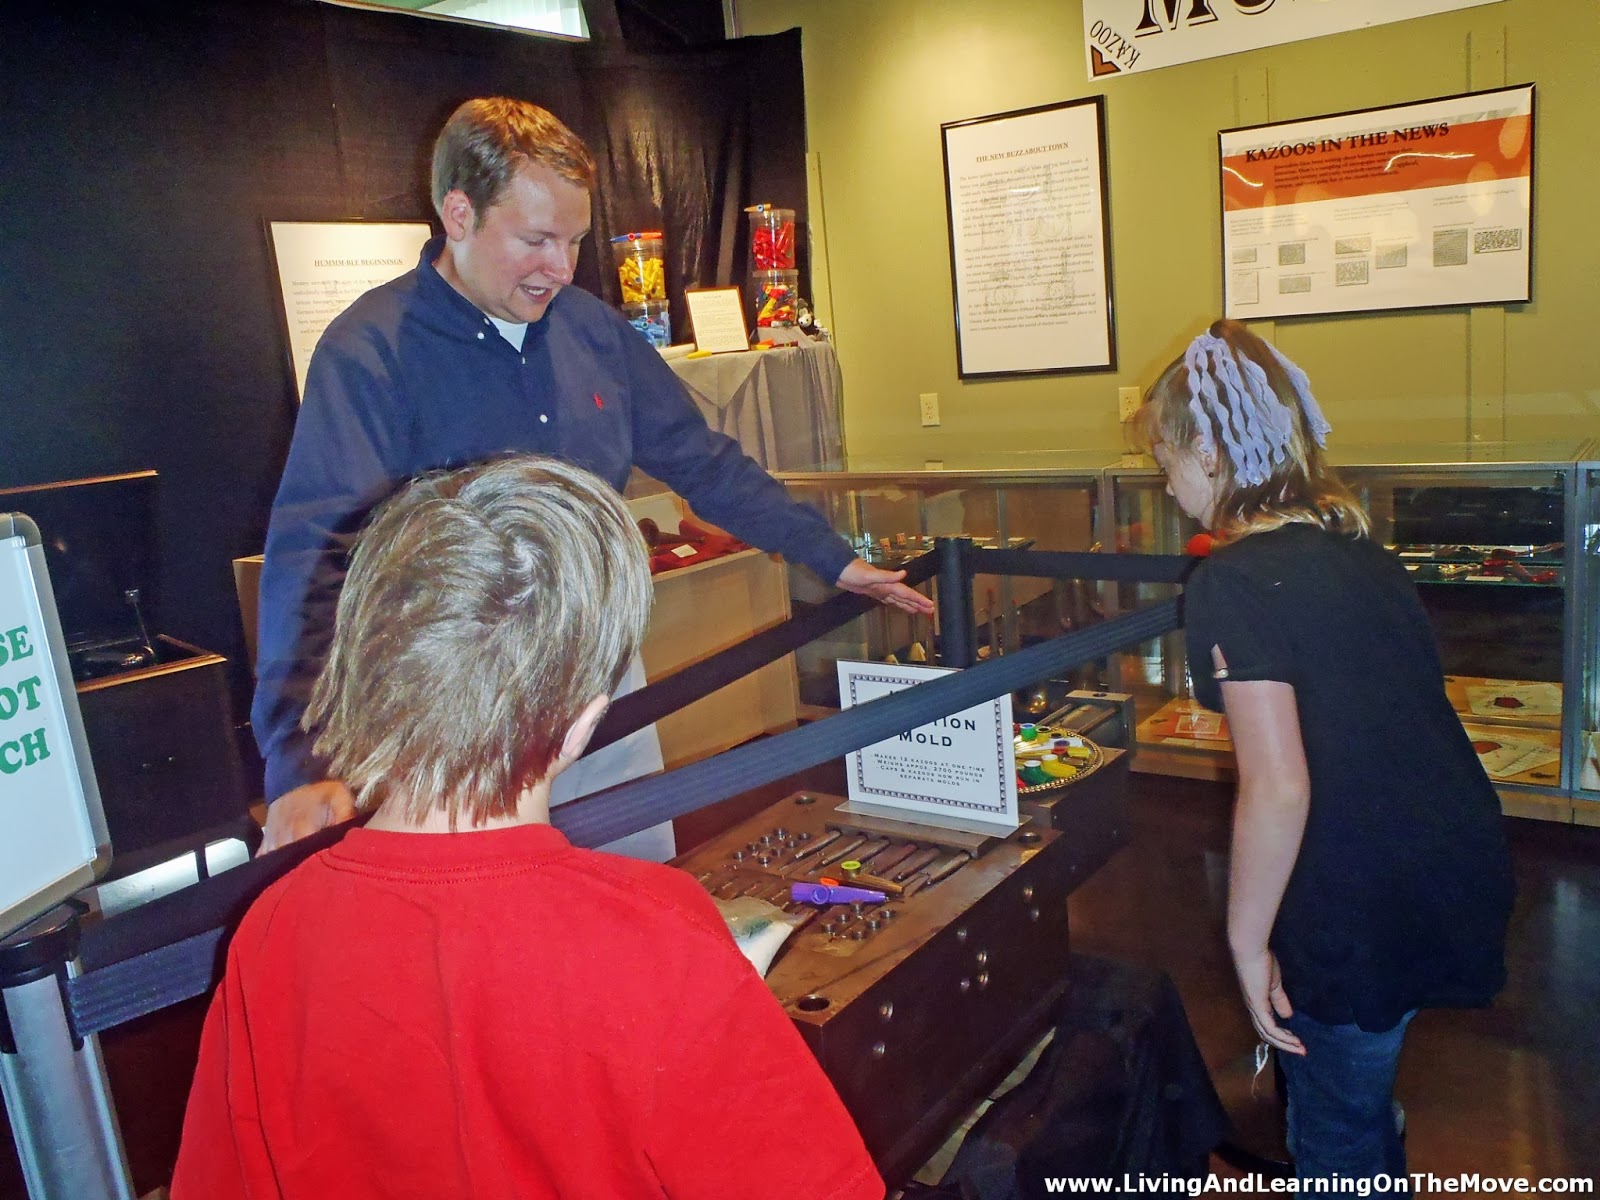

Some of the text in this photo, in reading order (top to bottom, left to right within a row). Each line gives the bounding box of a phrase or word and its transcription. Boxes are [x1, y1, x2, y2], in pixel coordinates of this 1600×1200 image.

[1090, 20, 1141, 69] KAZOO
[1006, 149, 1024, 158] BUZZ
[1024, 146, 1047, 155] ABOUT
[1048, 142, 1069, 151] TOWN
[1246, 122, 1450, 163] KAZOOS IN THE NEWS
[360, 258, 403, 267] BEGINNINGS
[0, 675, 41, 721] OT
[0, 727, 51, 775] CH
[899, 730, 952, 747] MOLD
